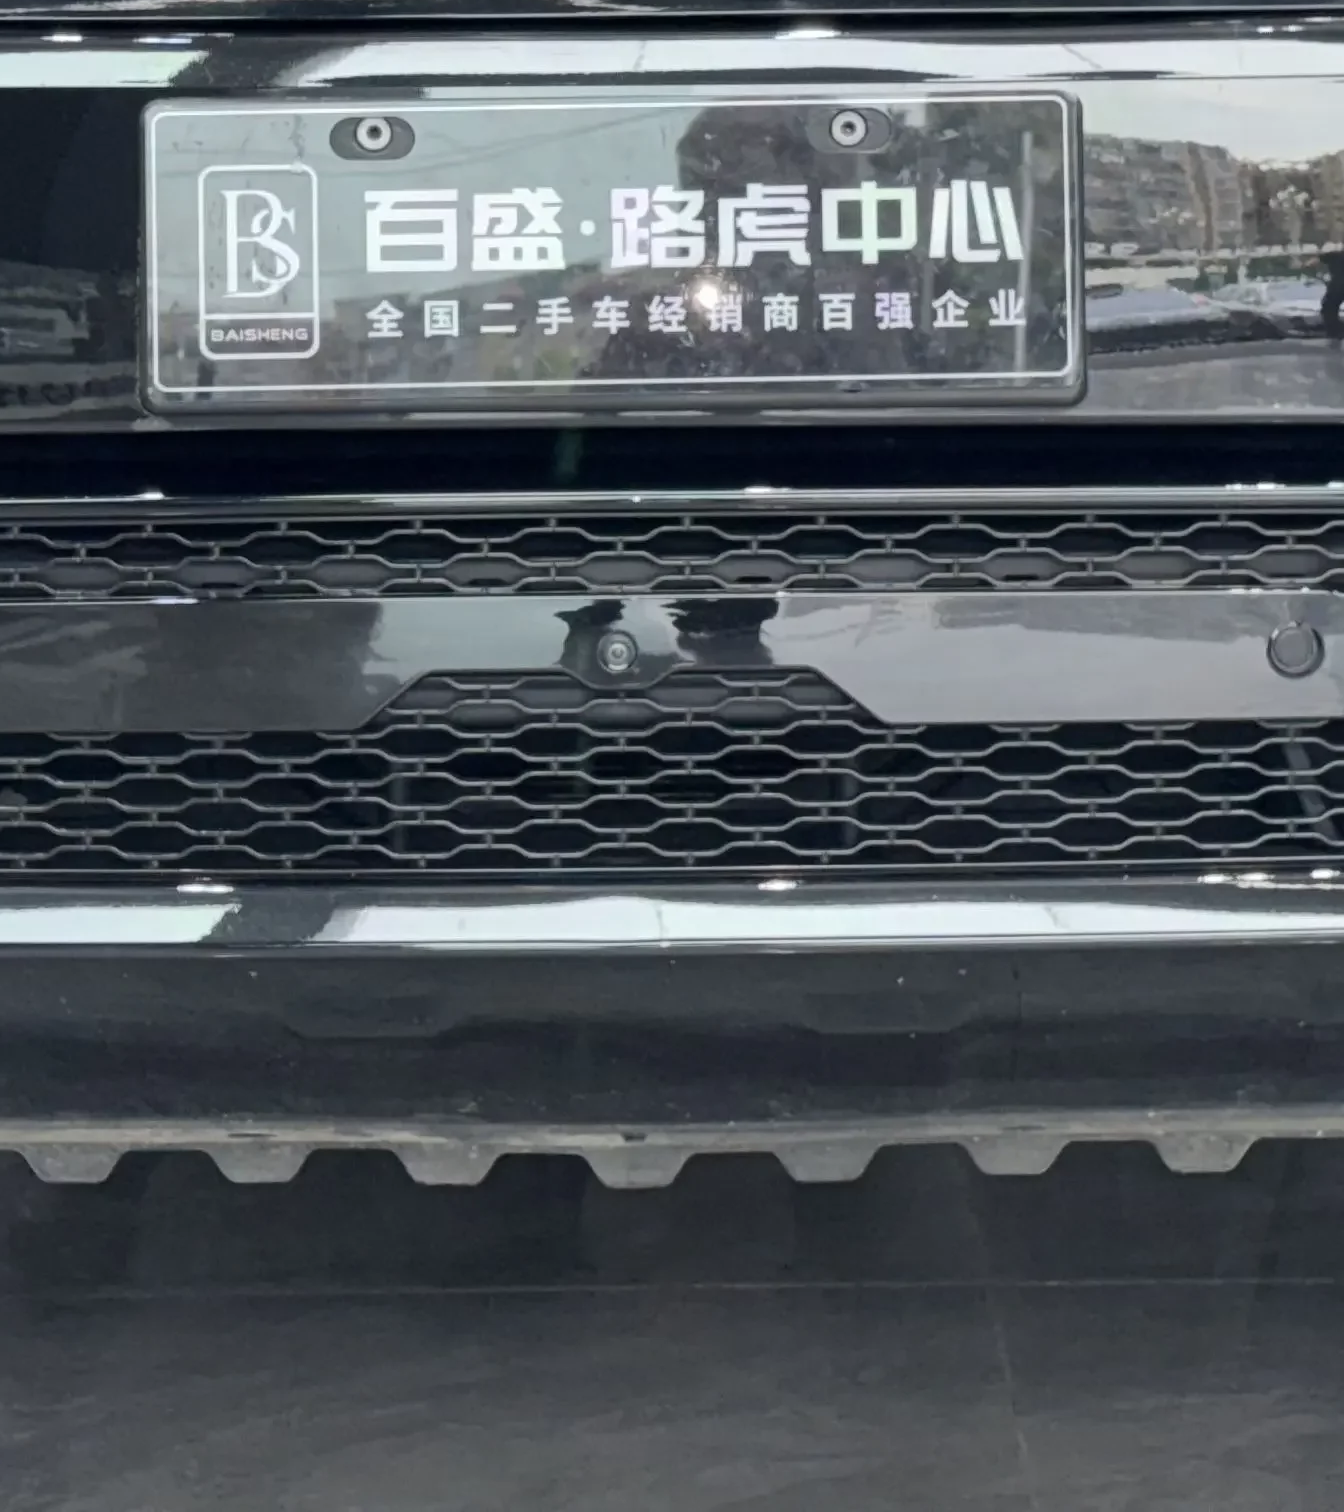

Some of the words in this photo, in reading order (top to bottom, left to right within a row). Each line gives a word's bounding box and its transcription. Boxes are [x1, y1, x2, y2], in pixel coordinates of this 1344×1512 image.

[366, 290, 1027, 340] 全国二手车经销商百强企业
[210, 327, 309, 342] BAISHENG
